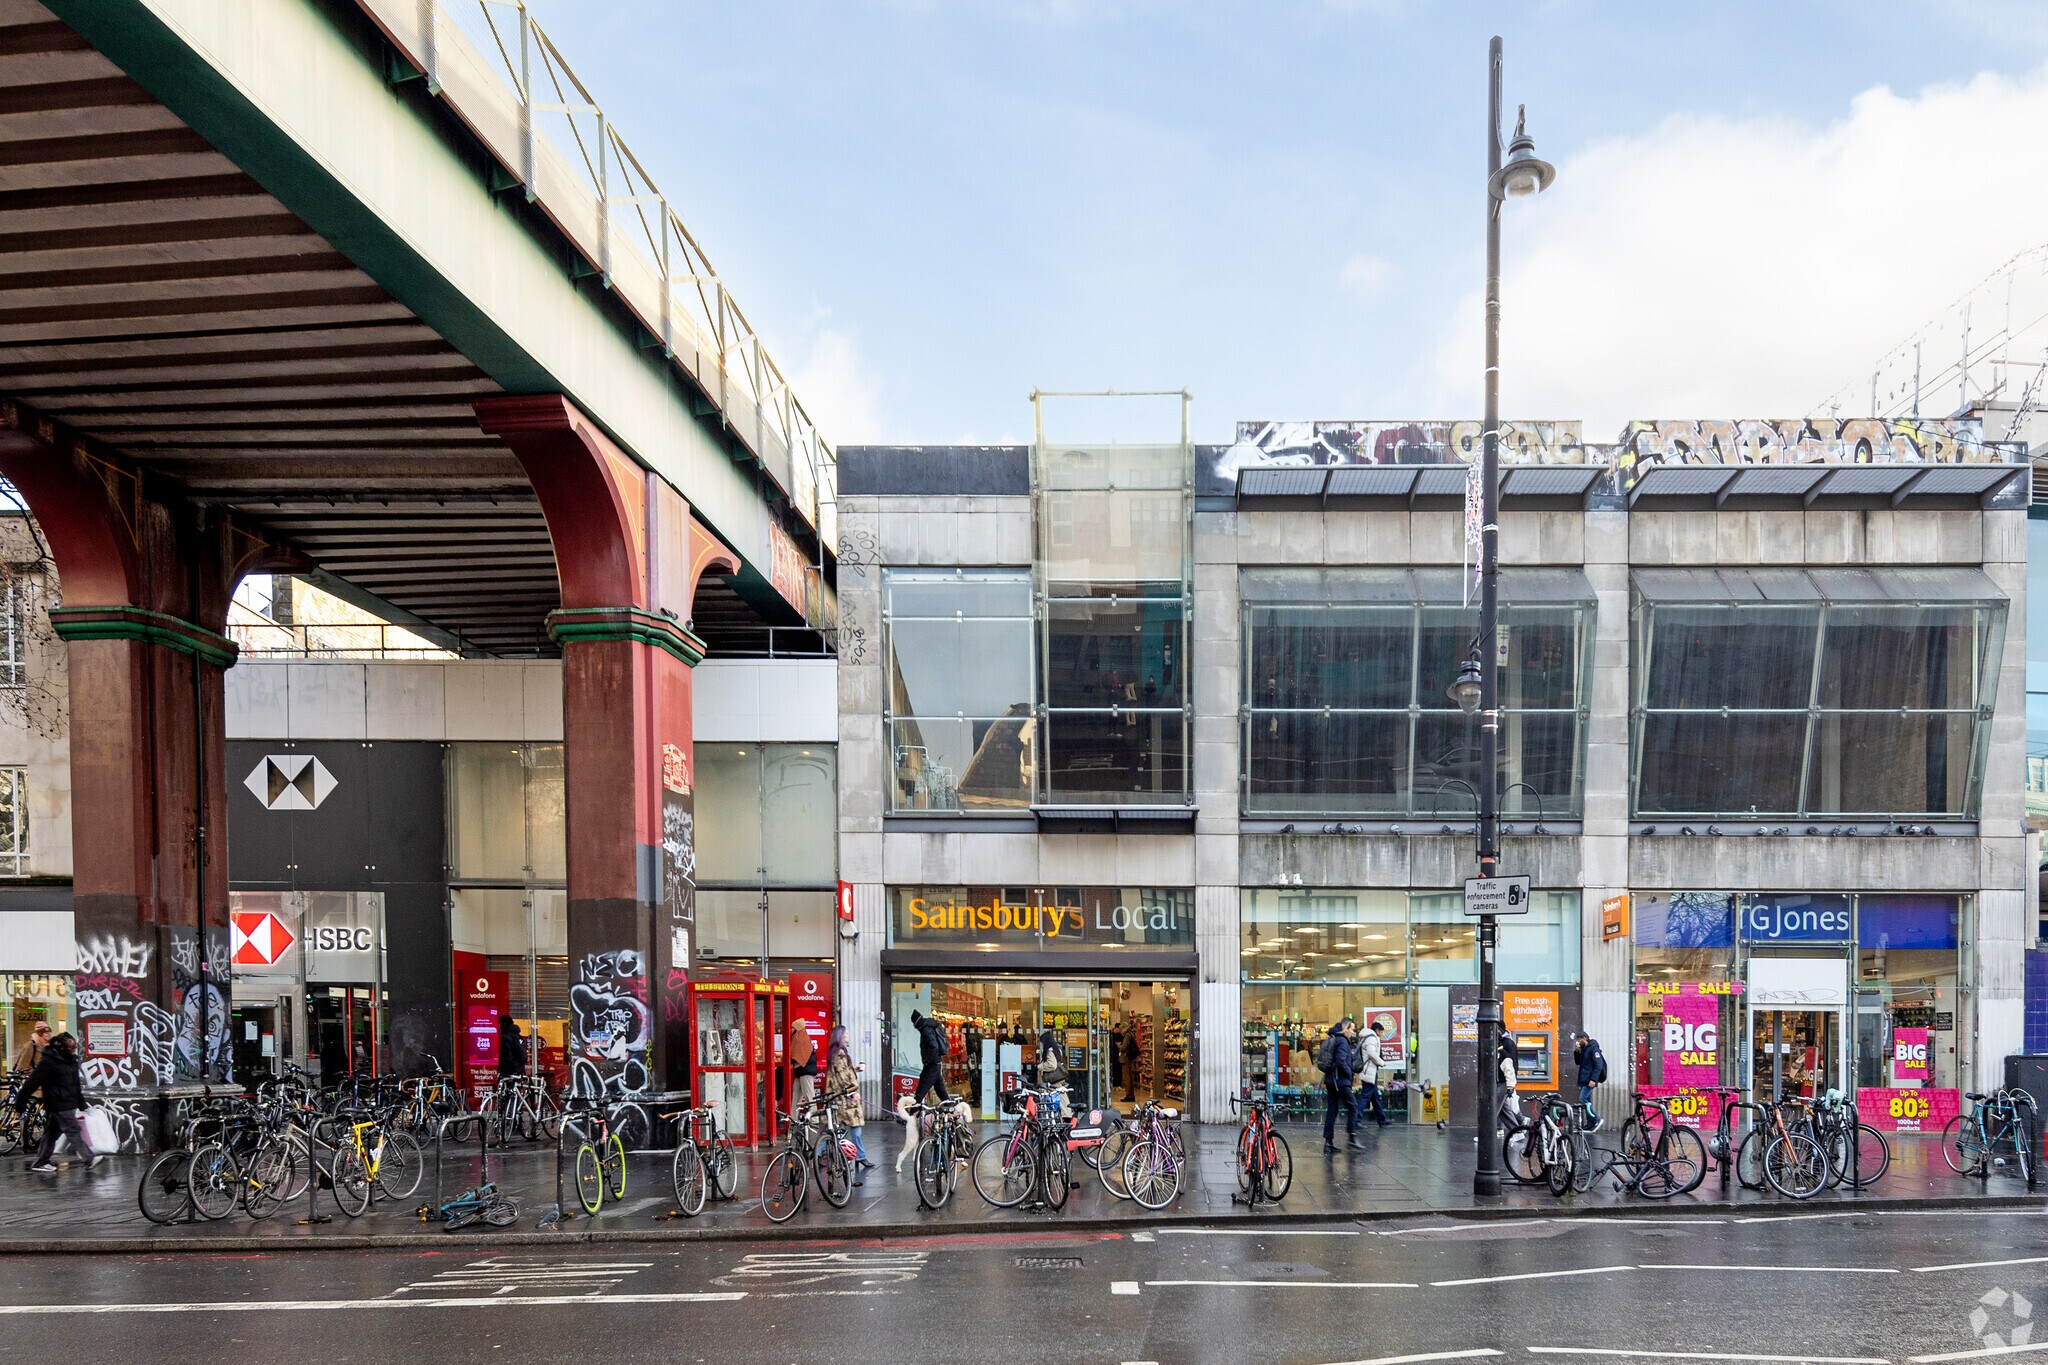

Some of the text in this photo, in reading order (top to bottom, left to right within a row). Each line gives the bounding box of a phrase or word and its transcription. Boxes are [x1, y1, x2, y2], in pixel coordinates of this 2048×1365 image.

[1476, 882, 1496, 890] Traffic
[1467, 892, 1506, 900] enforcement
[909, 897, 1177, 937] Sainsbury's Local
[304, 928, 371, 951] HSBC
[1648, 982, 1730, 994] SALE SALE
[1531, 996, 1548, 1004] cash
[1510, 1005, 1552, 1015] withdrawals
[18, 1012, 44, 1021] £22.50
[1665, 1015, 1681, 1024] The
[1664, 1024, 1716, 1051] BIG
[1896, 1044, 1926, 1060] BIG
[1680, 1052, 1716, 1066] SALE
[1905, 1060, 1926, 1068] SALE
[1890, 1098, 1928, 1118] 80%
